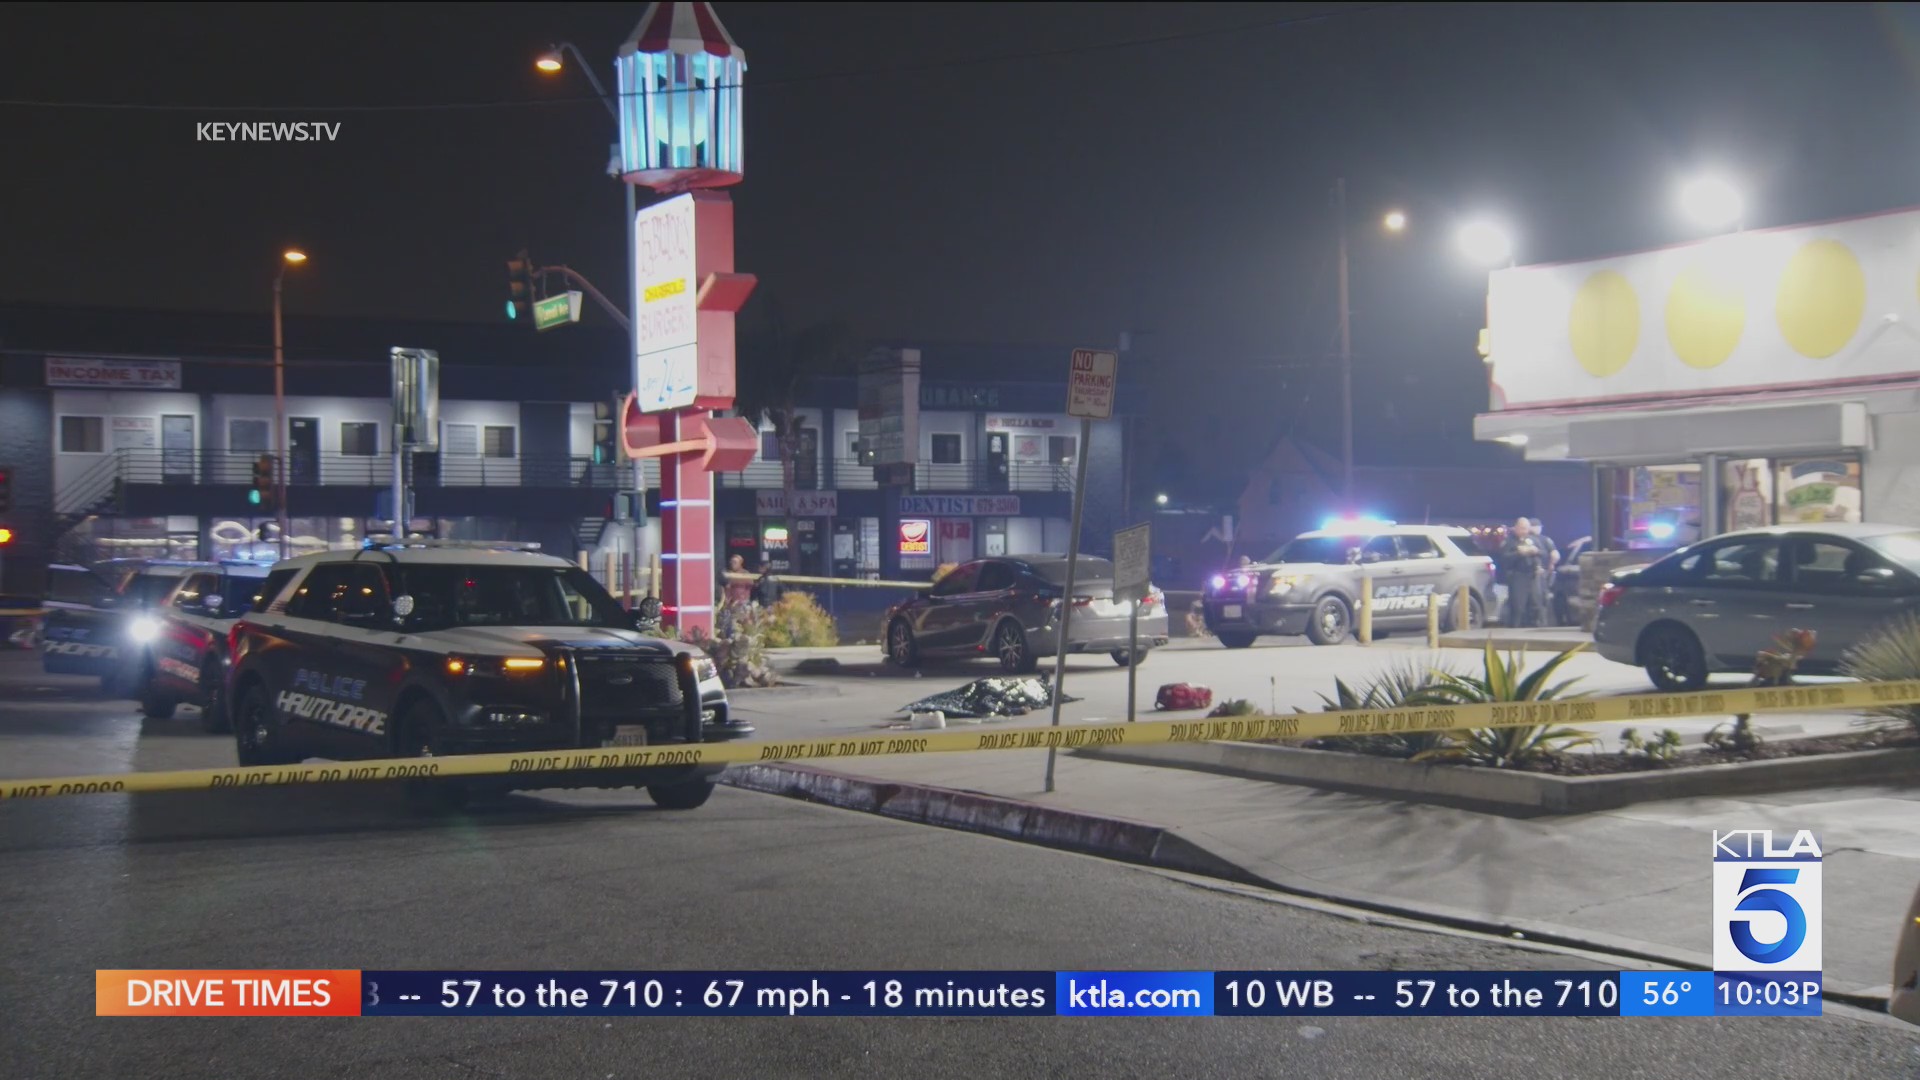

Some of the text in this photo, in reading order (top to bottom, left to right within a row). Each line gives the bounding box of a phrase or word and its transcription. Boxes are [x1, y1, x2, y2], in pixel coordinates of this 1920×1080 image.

[1075, 351, 1093, 370] NO
[50, 366, 176, 381] INCOME TAX
[1074, 372, 1112, 389] PARKING
[757, 496, 790, 509] NAIL
[900, 496, 973, 514] DENTIST
[763, 539, 789, 550] WAX
[1374, 583, 1436, 599] POLICE
[294, 668, 368, 700] POLICE
[277, 690, 388, 736] HAWTHORNE
[1338, 710, 1455, 733] POLICE LINE DO NOT CROSS
[978, 728, 1125, 749] POLICE LINE DO NOT CROSS
[1168, 719, 1299, 741] POLICE LINE DO NOT CROSS
[760, 739, 928, 760] POLICE LINE DO NOT CROSS
[509, 750, 702, 772] POLICE LINE DO NOT CROSS
[210, 764, 439, 788] POLICE LINE DO NOT CROSS
